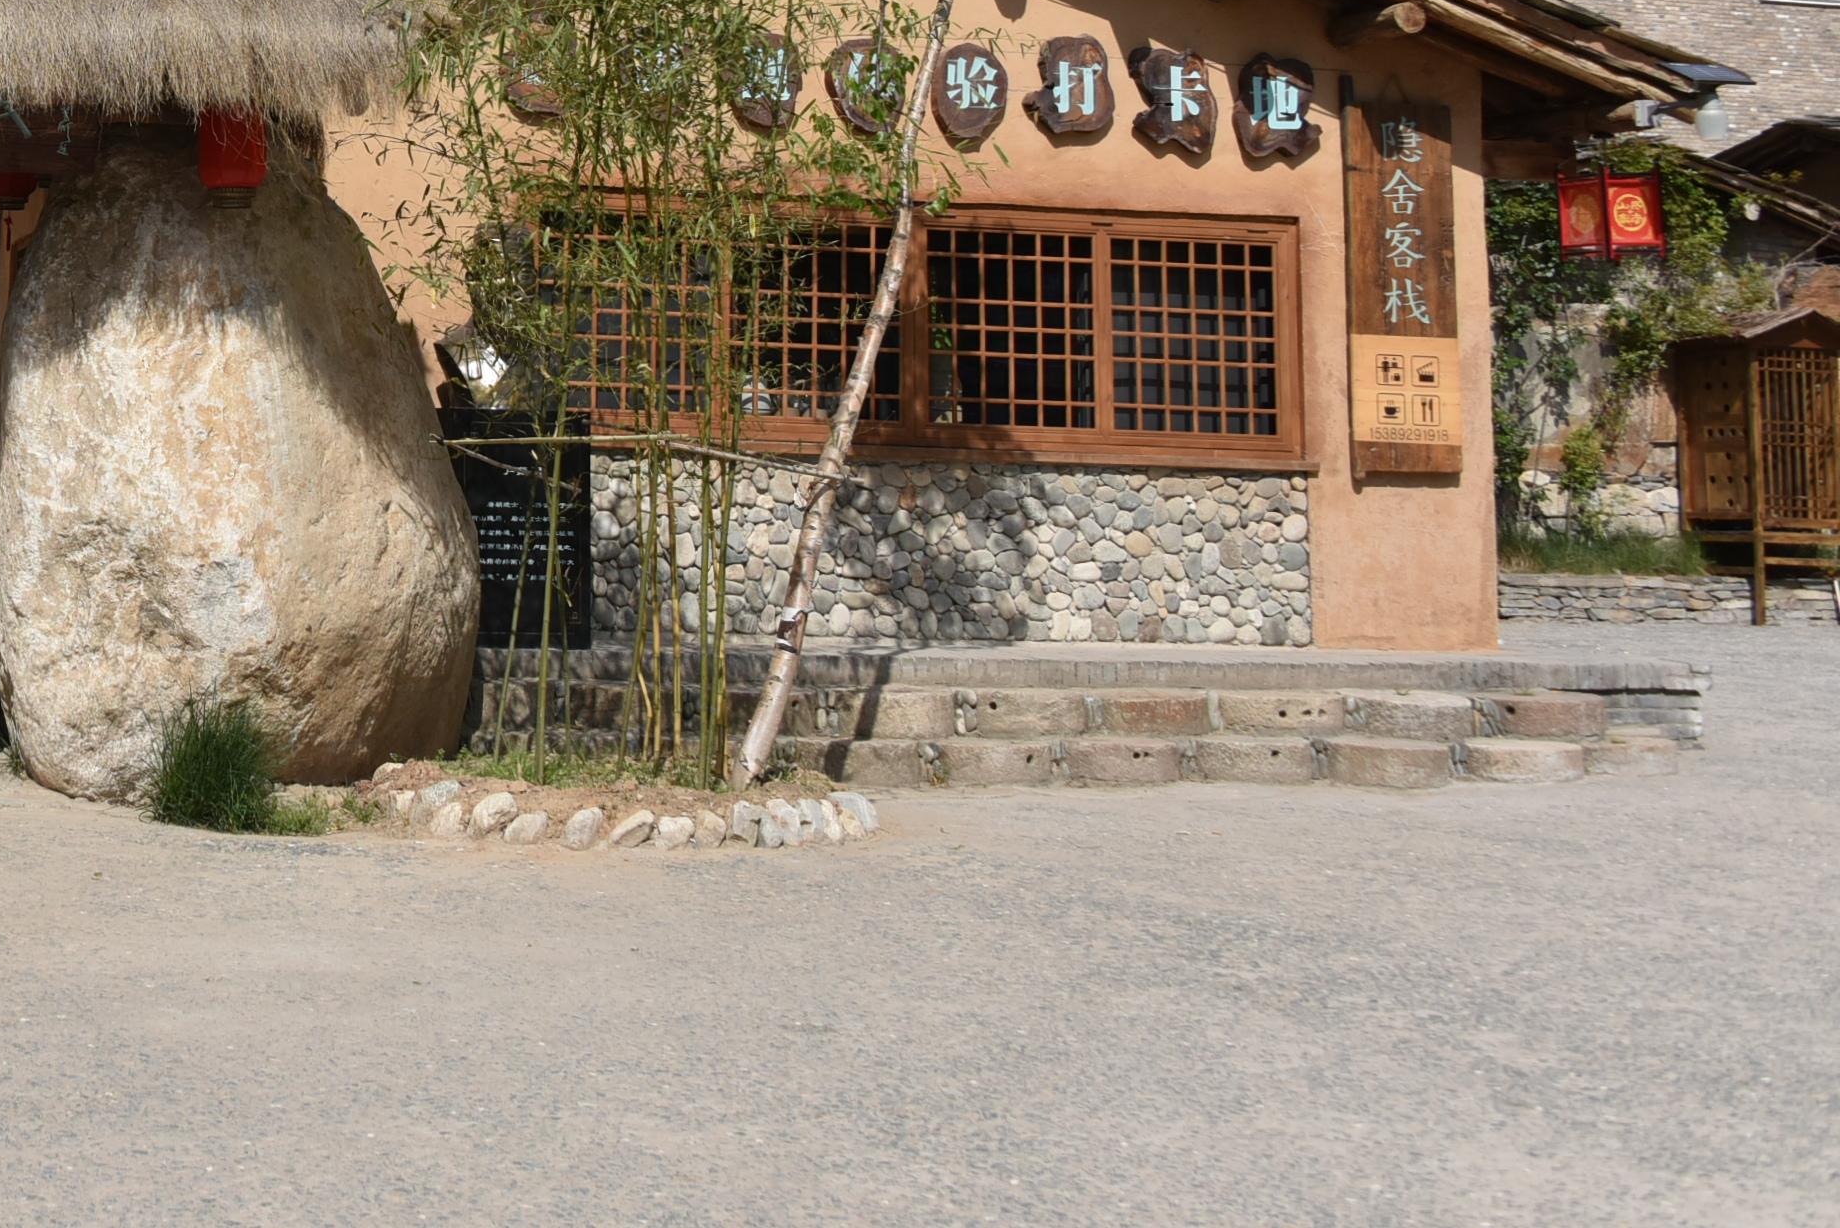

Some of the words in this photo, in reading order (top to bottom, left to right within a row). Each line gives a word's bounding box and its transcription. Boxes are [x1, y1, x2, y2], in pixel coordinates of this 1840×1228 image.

[1380, 116, 1432, 326] 隐舍客栈
[1369, 426, 1449, 442] 15389291918
